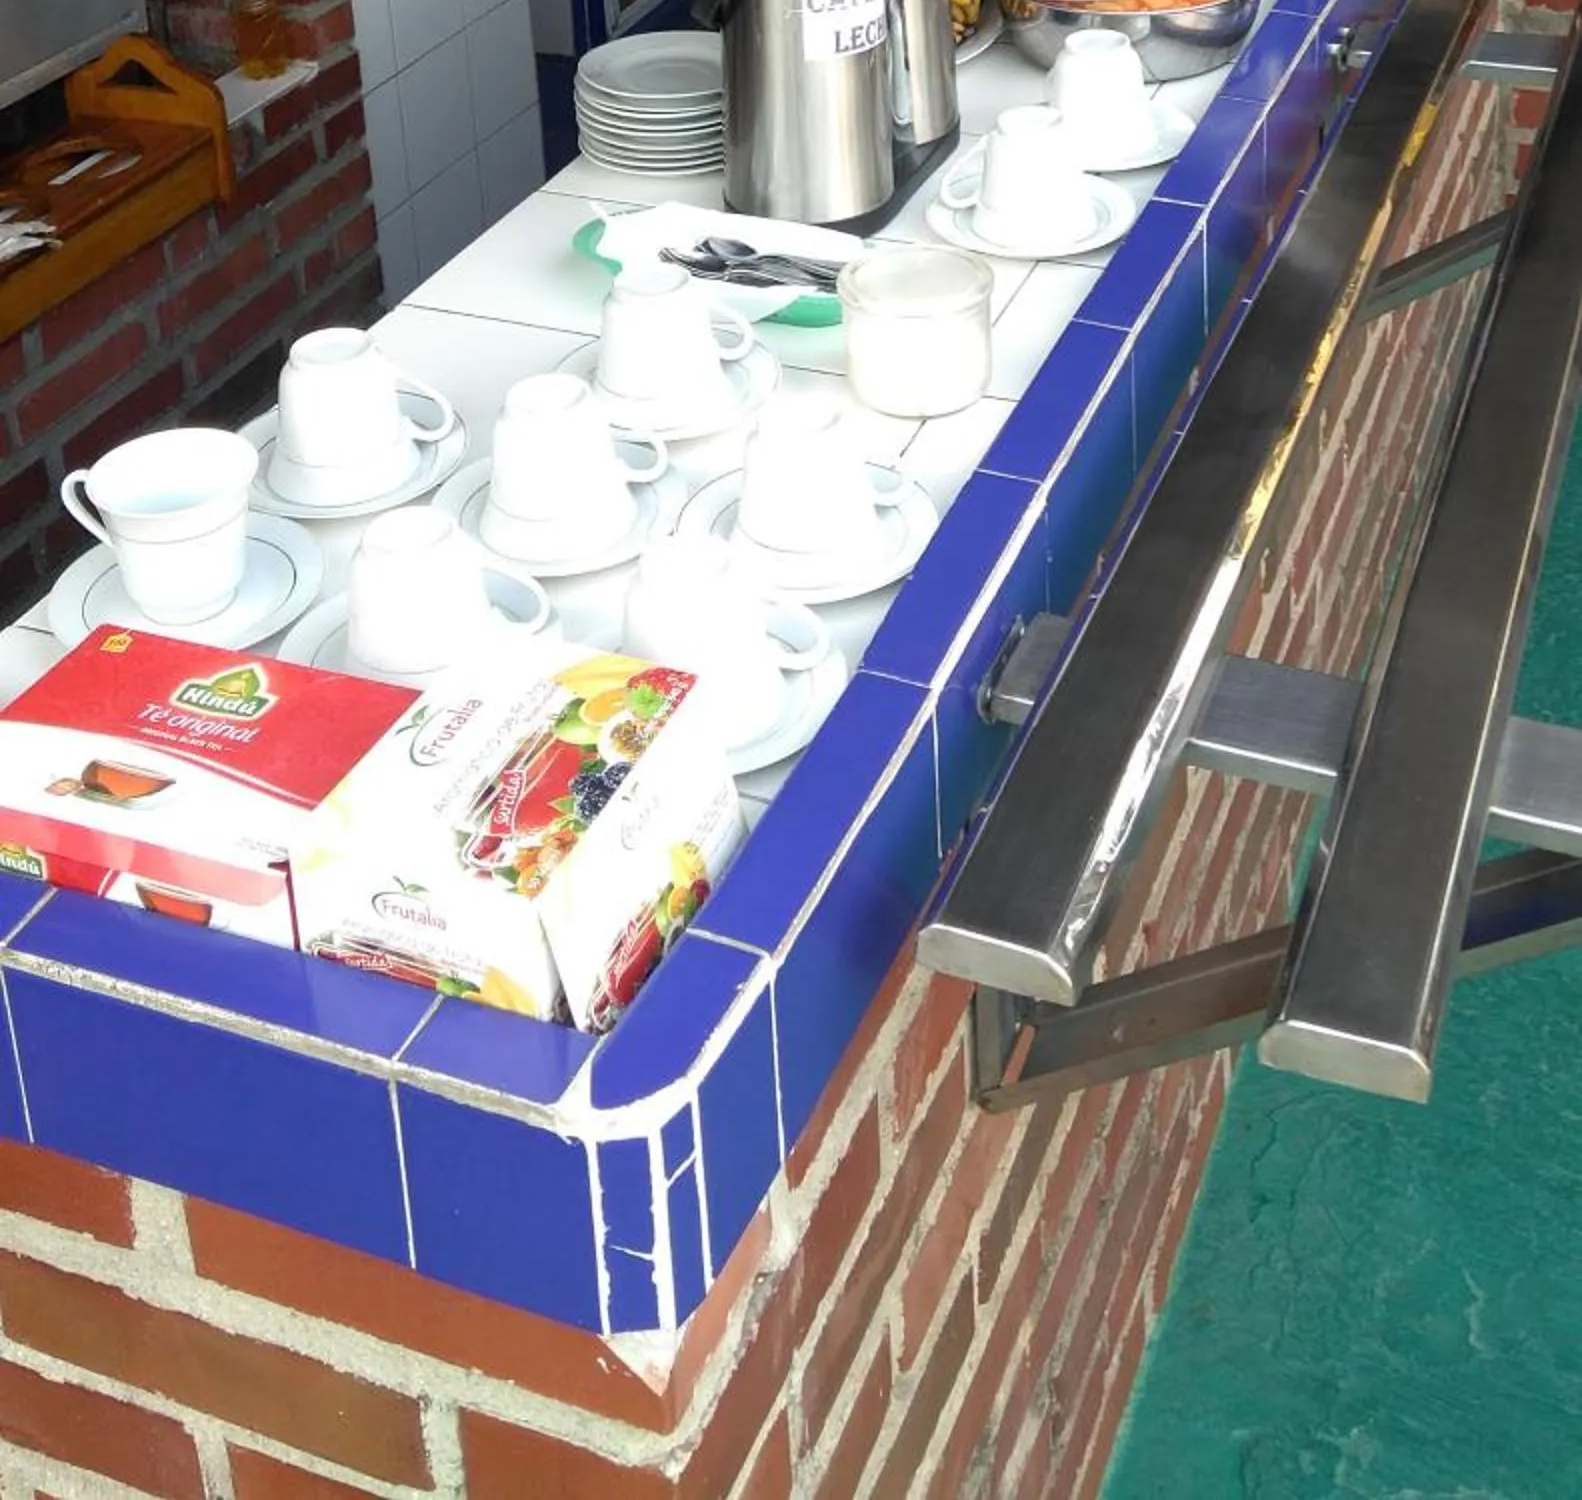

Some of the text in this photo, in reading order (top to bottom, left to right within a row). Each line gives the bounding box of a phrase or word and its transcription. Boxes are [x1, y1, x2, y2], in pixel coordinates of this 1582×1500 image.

[181, 687, 258, 716] Hindú
[137, 702, 261, 744] Té original
[419, 698, 484, 758] Frutalia
[381, 898, 449, 932] Frutalia
